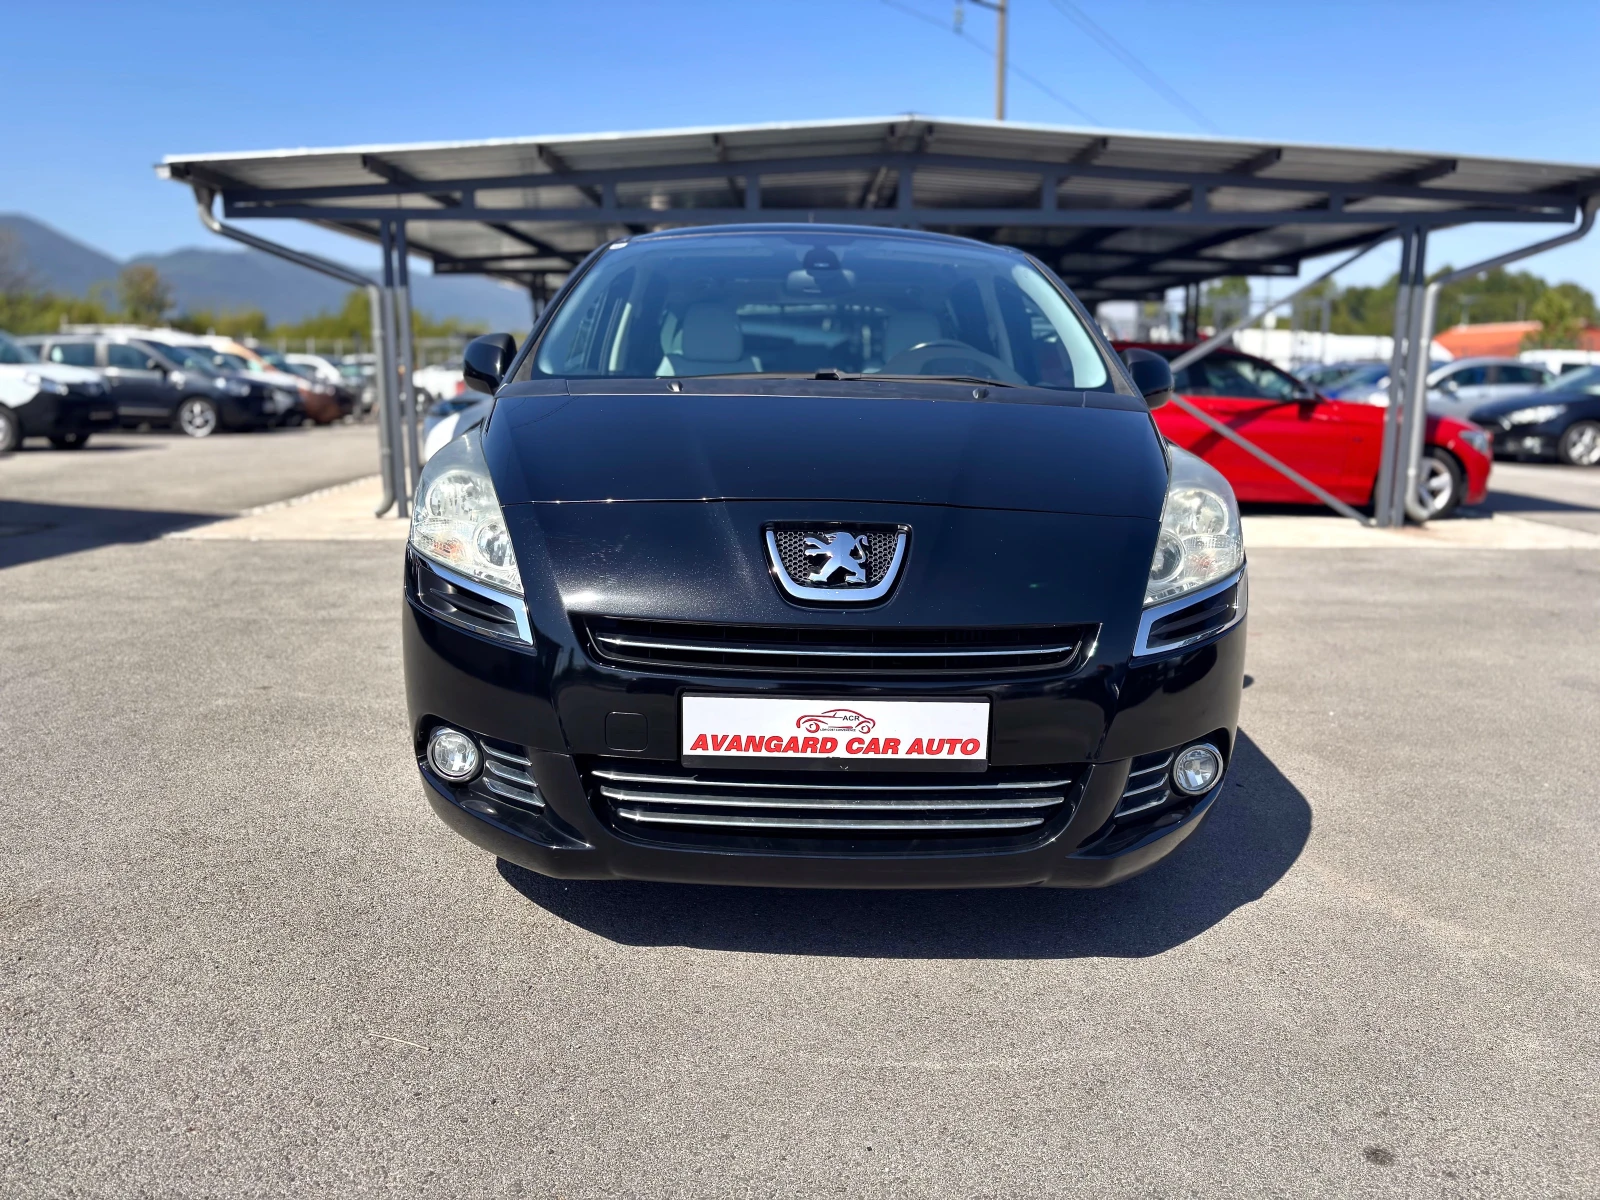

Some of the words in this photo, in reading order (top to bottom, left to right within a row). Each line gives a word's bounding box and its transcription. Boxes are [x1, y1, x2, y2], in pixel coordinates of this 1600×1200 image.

[690, 733, 838, 754] AVANGARD
[845, 738, 901, 755] CAR
[905, 738, 980, 755] AUTO
